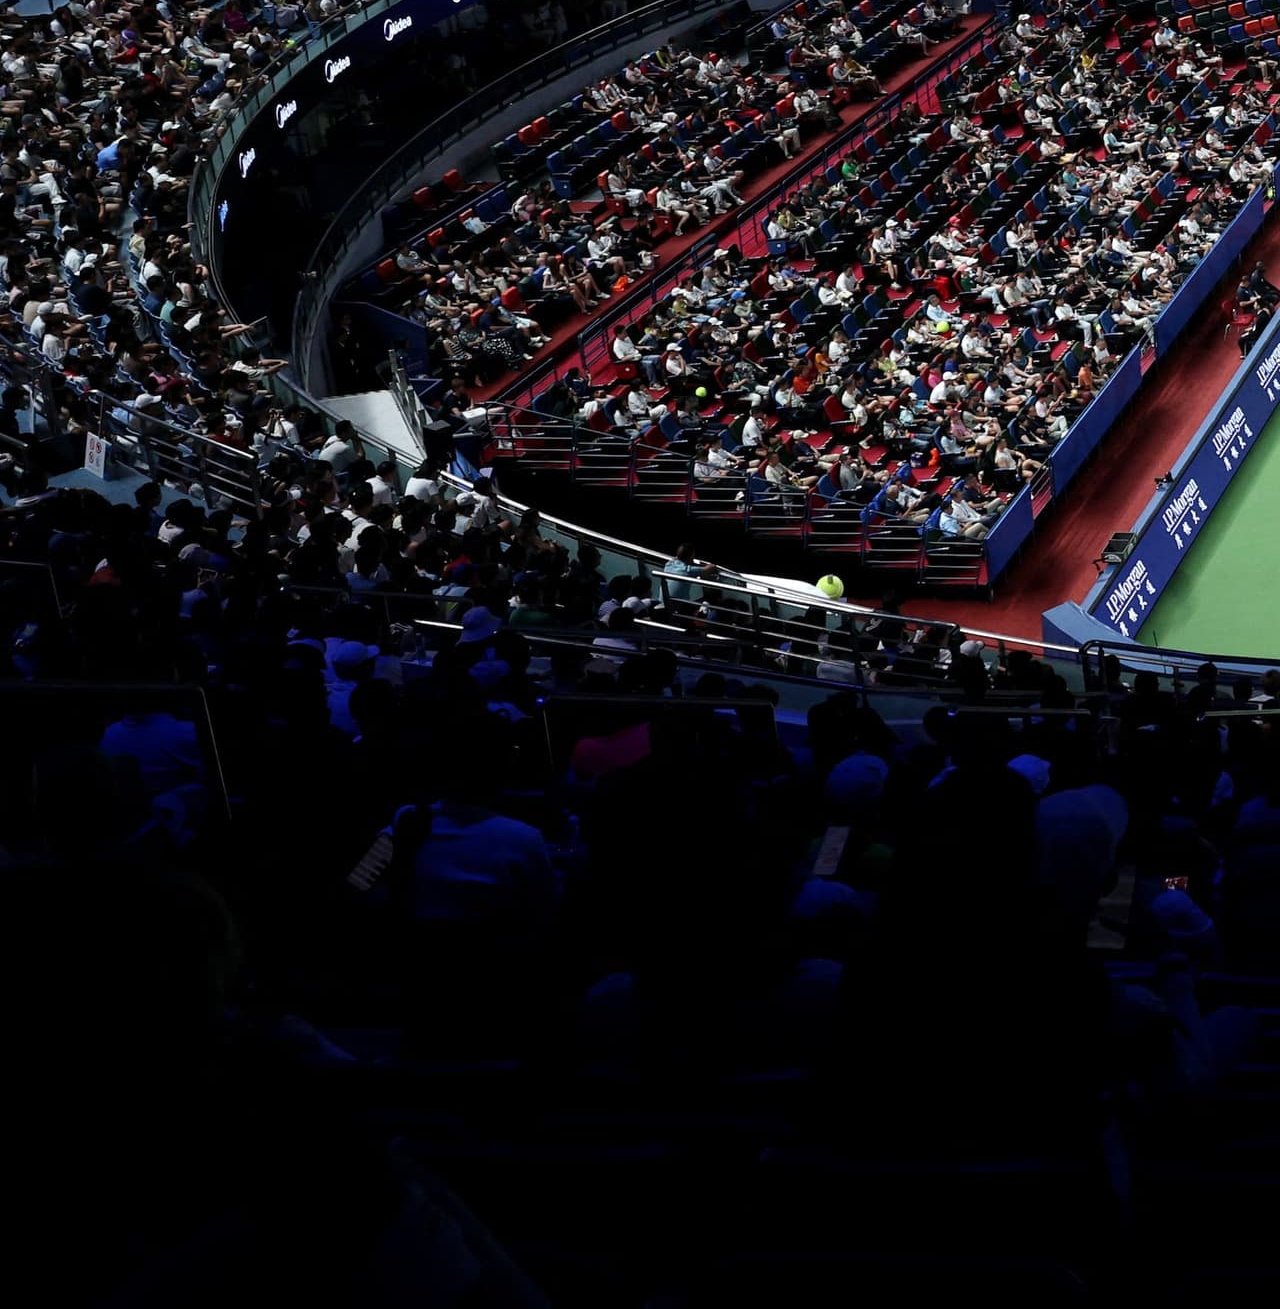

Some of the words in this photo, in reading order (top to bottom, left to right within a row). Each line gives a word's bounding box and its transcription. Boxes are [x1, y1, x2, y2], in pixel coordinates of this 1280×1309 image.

[384, 16, 412, 41] Midea
[325, 56, 350, 83] Midea
[276, 100, 297, 128] Midea
[1212, 406, 1245, 456] J.P.Morgan
[1162, 478, 1199, 533] J.P.Morgan
[1105, 560, 1146, 621] J.P.Morgan
